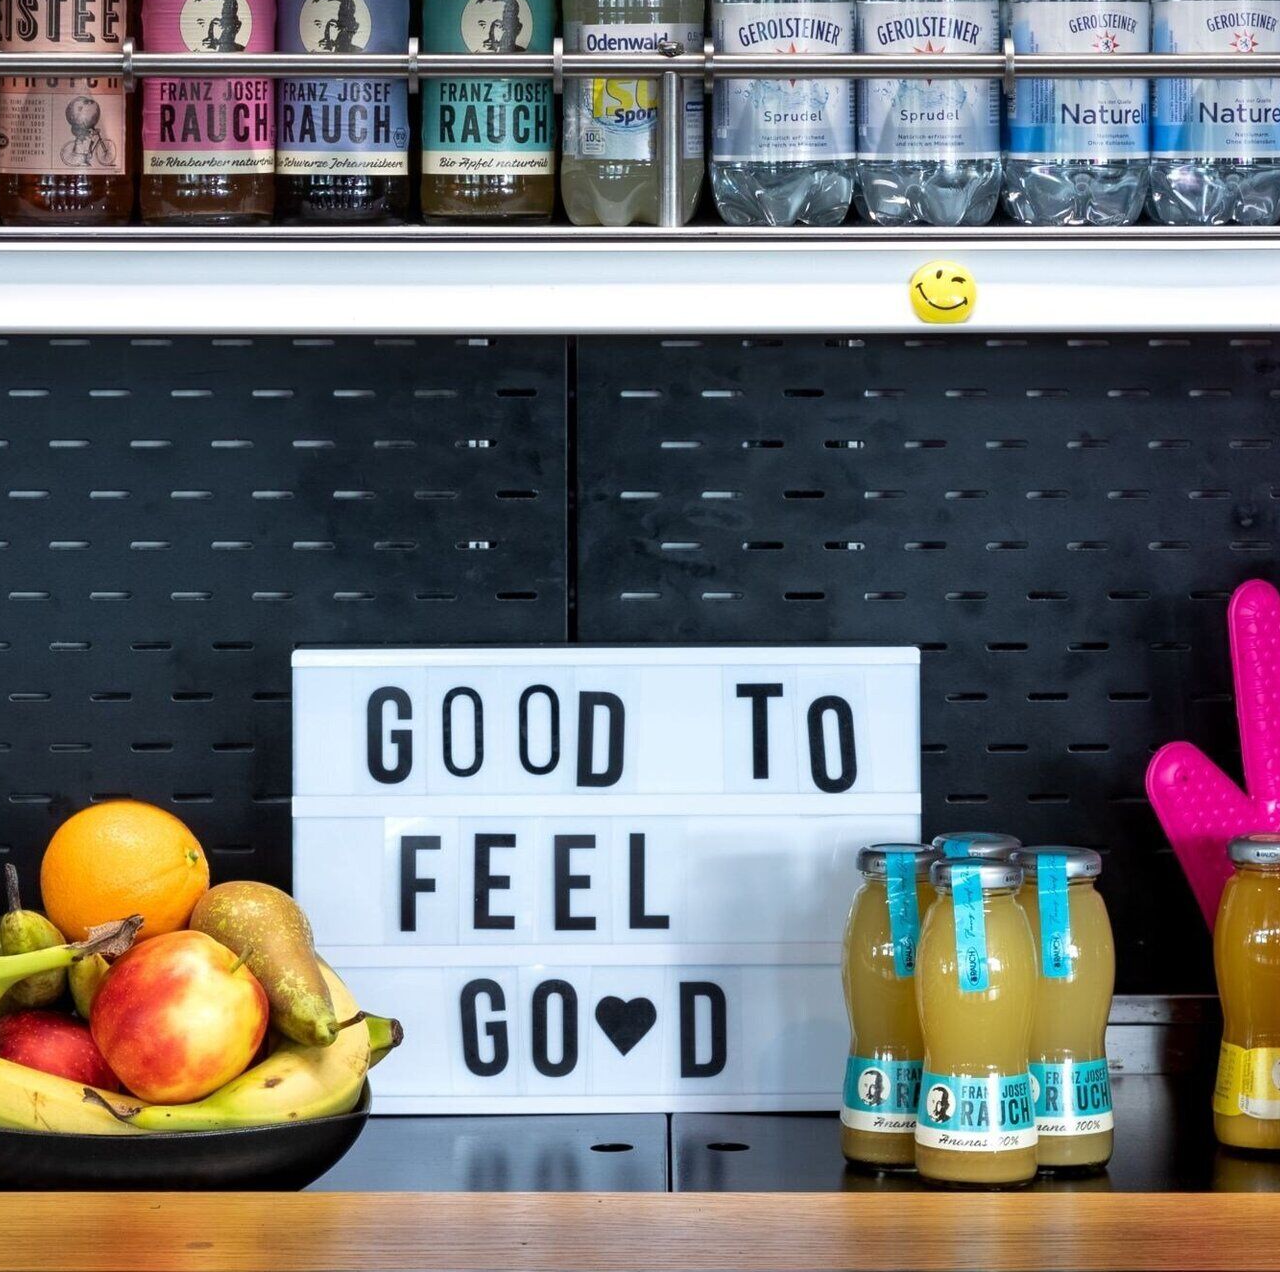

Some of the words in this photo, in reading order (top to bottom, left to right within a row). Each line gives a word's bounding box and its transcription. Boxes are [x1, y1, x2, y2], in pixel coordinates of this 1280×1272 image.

[738, 17, 841, 47] GEROLSTEINER
[877, 16, 981, 46] GEROLSTEINER
[1069, 12, 1137, 35] GEROLSTEINER
[1206, 12, 1277, 34] GEROLSTEINER
[161, 81, 211, 102] FRANZ
[223, 81, 268, 101] JOSEF
[284, 83, 324, 103] FRANZ
[337, 83, 391, 103] JOSEF
[440, 82, 491, 103] FRANZ
[502, 82, 548, 103] JOSEF
[160, 104, 268, 143] RAUCH
[283, 105, 391, 144] RAUCH
[440, 104, 548, 144] RAUCH
[763, 109, 823, 124] Sprudel
[900, 108, 959, 123] Sprudel
[1061, 102, 1148, 125] Naturell
[165, 156, 231, 168] Rhabarber
[283, 156, 328, 168] Schwarze
[328, 156, 403, 170] Johannisbeere
[439, 157, 456, 168] Bio
[366, 684, 625, 788] GOOD
[736, 683, 857, 793] TO
[400, 833, 670, 932] FEEL
[938, 1134, 988, 1147] Ananas
